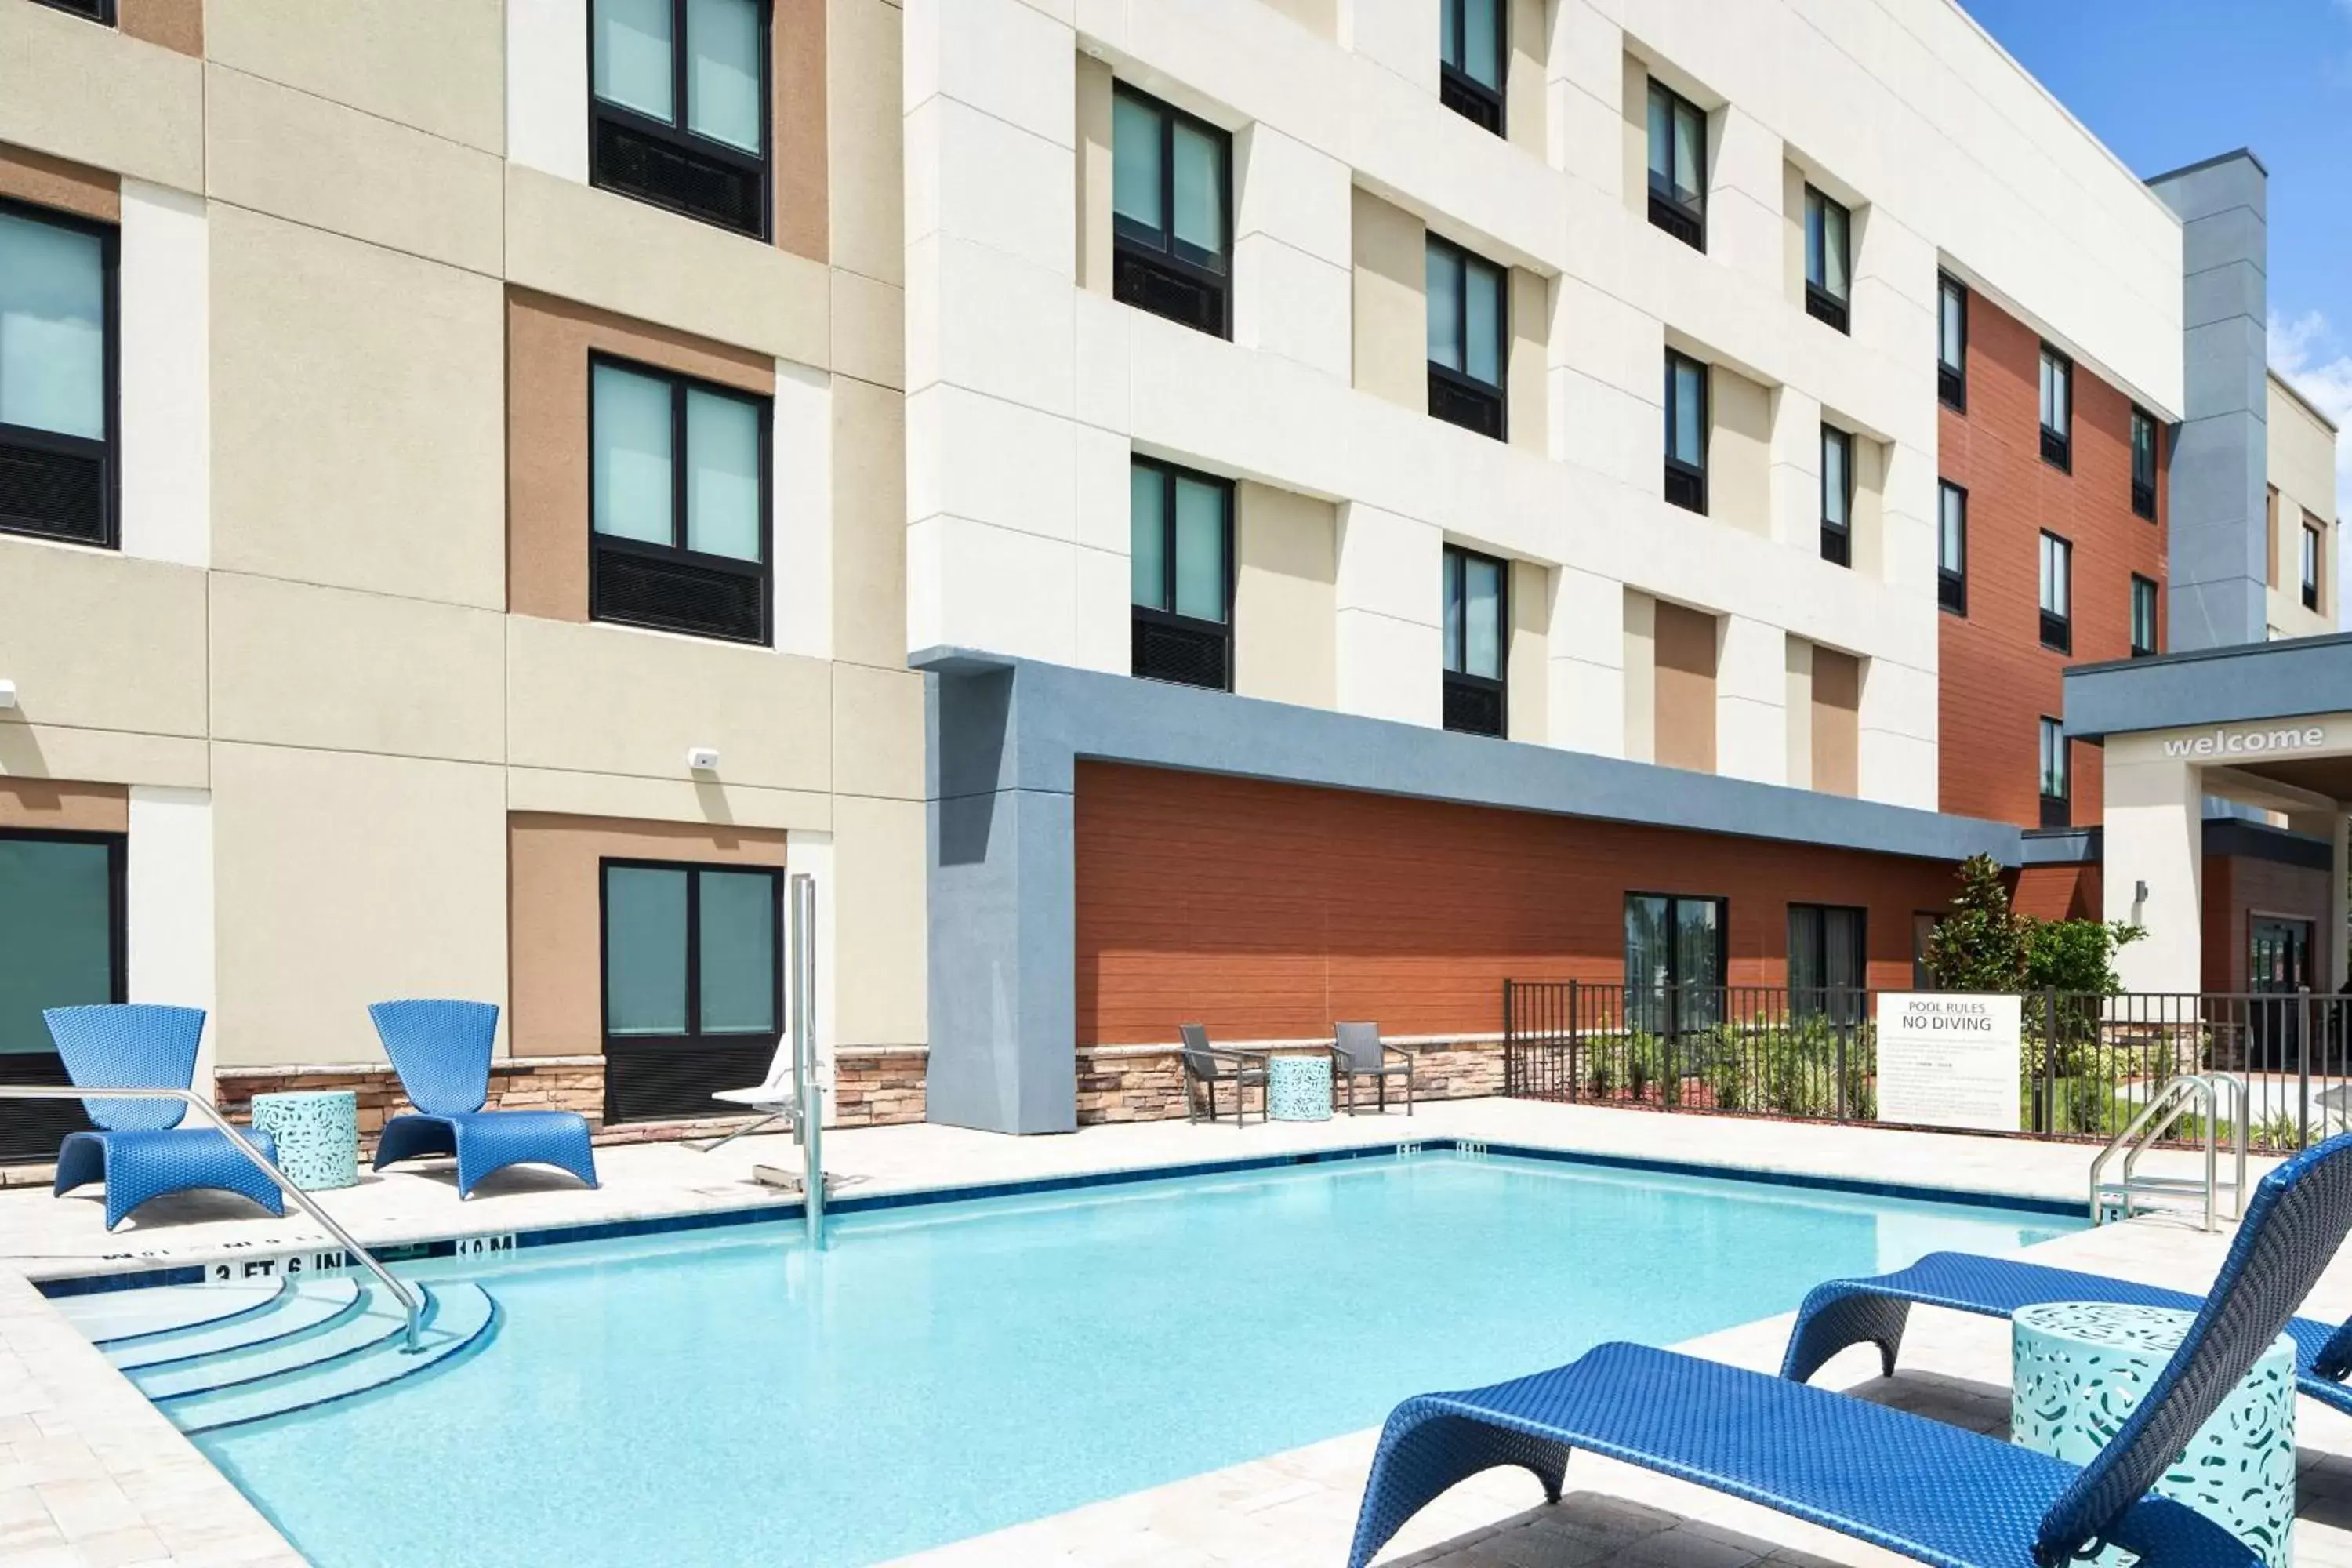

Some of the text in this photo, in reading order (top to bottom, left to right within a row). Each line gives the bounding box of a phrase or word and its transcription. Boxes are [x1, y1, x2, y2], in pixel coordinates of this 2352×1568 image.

[2164, 728, 2324, 757] welcome
[1909, 1001, 1985, 1014] POOL RULES
[1903, 1015, 1991, 1031] NO DIVING
[245, 1260, 274, 1278] FT
[316, 1252, 342, 1270] IN
